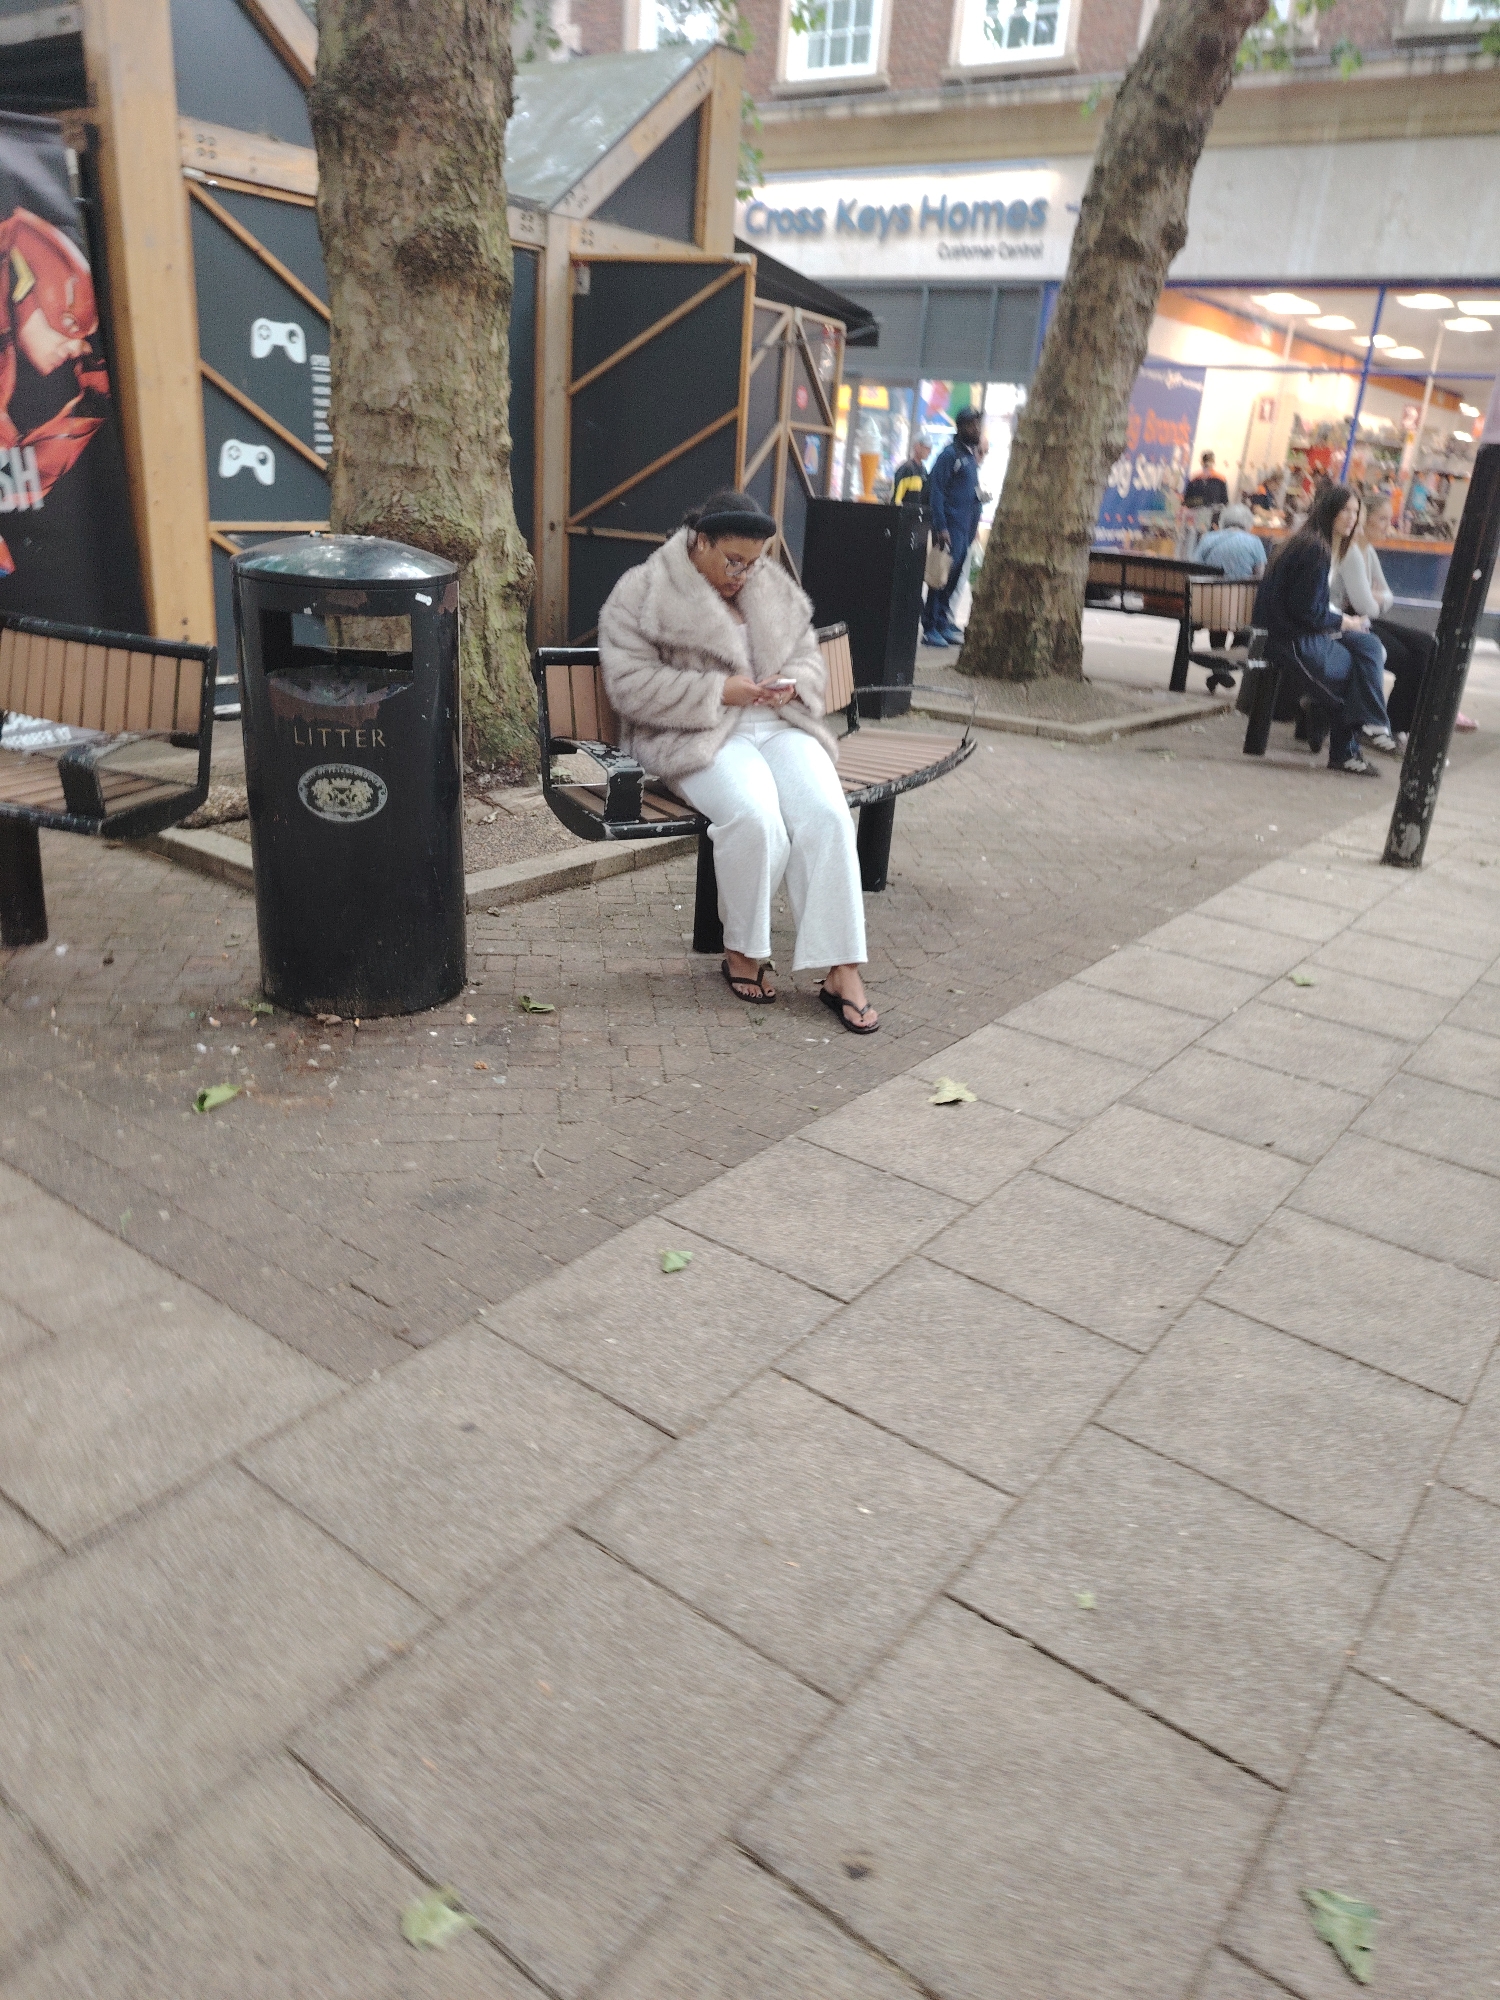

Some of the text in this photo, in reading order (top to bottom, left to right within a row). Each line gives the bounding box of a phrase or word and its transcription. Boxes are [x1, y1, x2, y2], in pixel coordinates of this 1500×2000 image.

[745, 193, 1049, 243] Cross Keys Homes
[294, 725, 386, 748] LITTER
